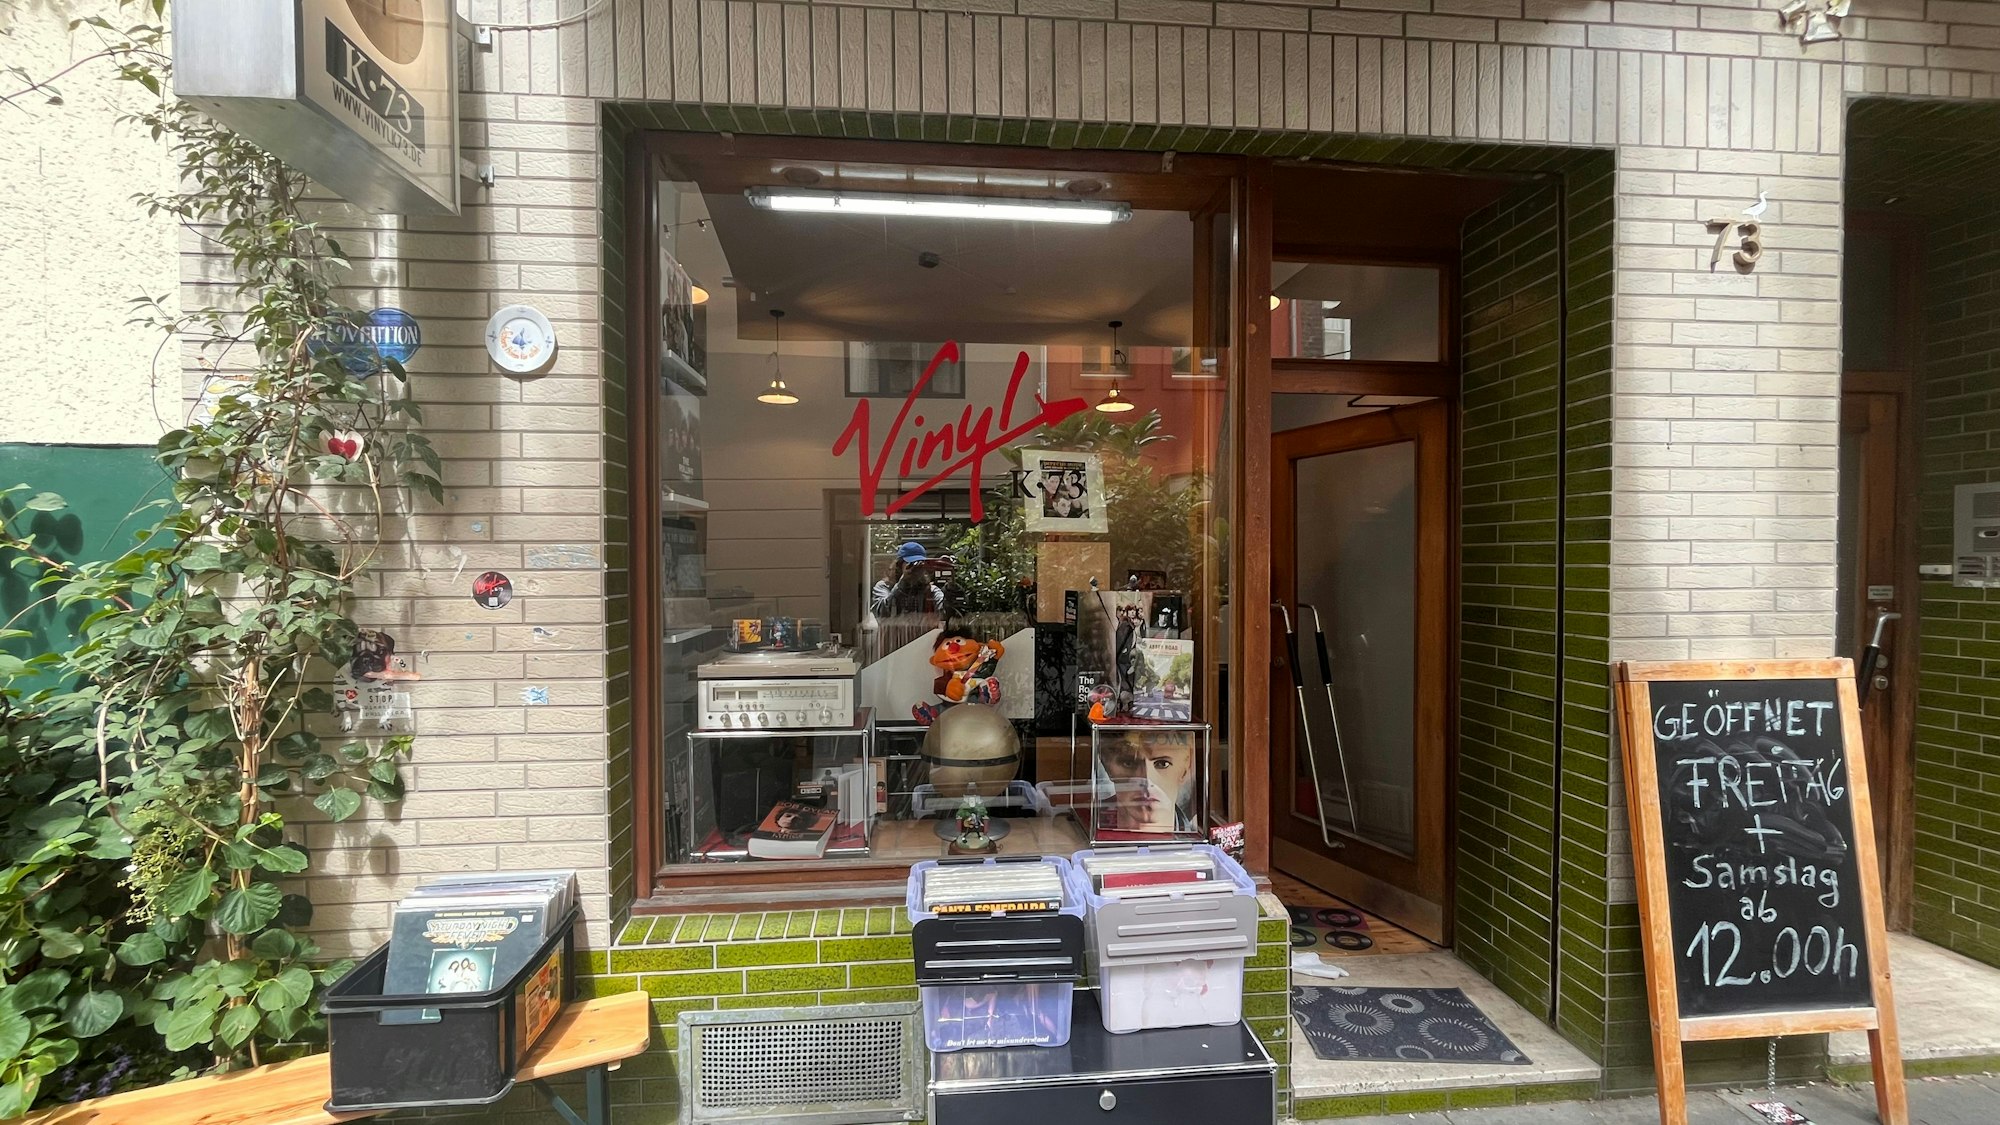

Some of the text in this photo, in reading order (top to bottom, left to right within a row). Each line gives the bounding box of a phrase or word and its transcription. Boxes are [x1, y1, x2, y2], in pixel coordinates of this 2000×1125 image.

[332, 81, 423, 168] WWW.VINYLK73.DE
[1704, 218, 1762, 269] 73
[832, 340, 1088, 522] Vinyl
[1078, 676, 1094, 685] The
[1654, 689, 1834, 741] GEÖFFNET
[1677, 746, 1845, 811] FREITAG
[1221, 835, 1237, 844] DAY
[1739, 890, 1777, 922] ab
[1686, 921, 1858, 987] 12.00h
